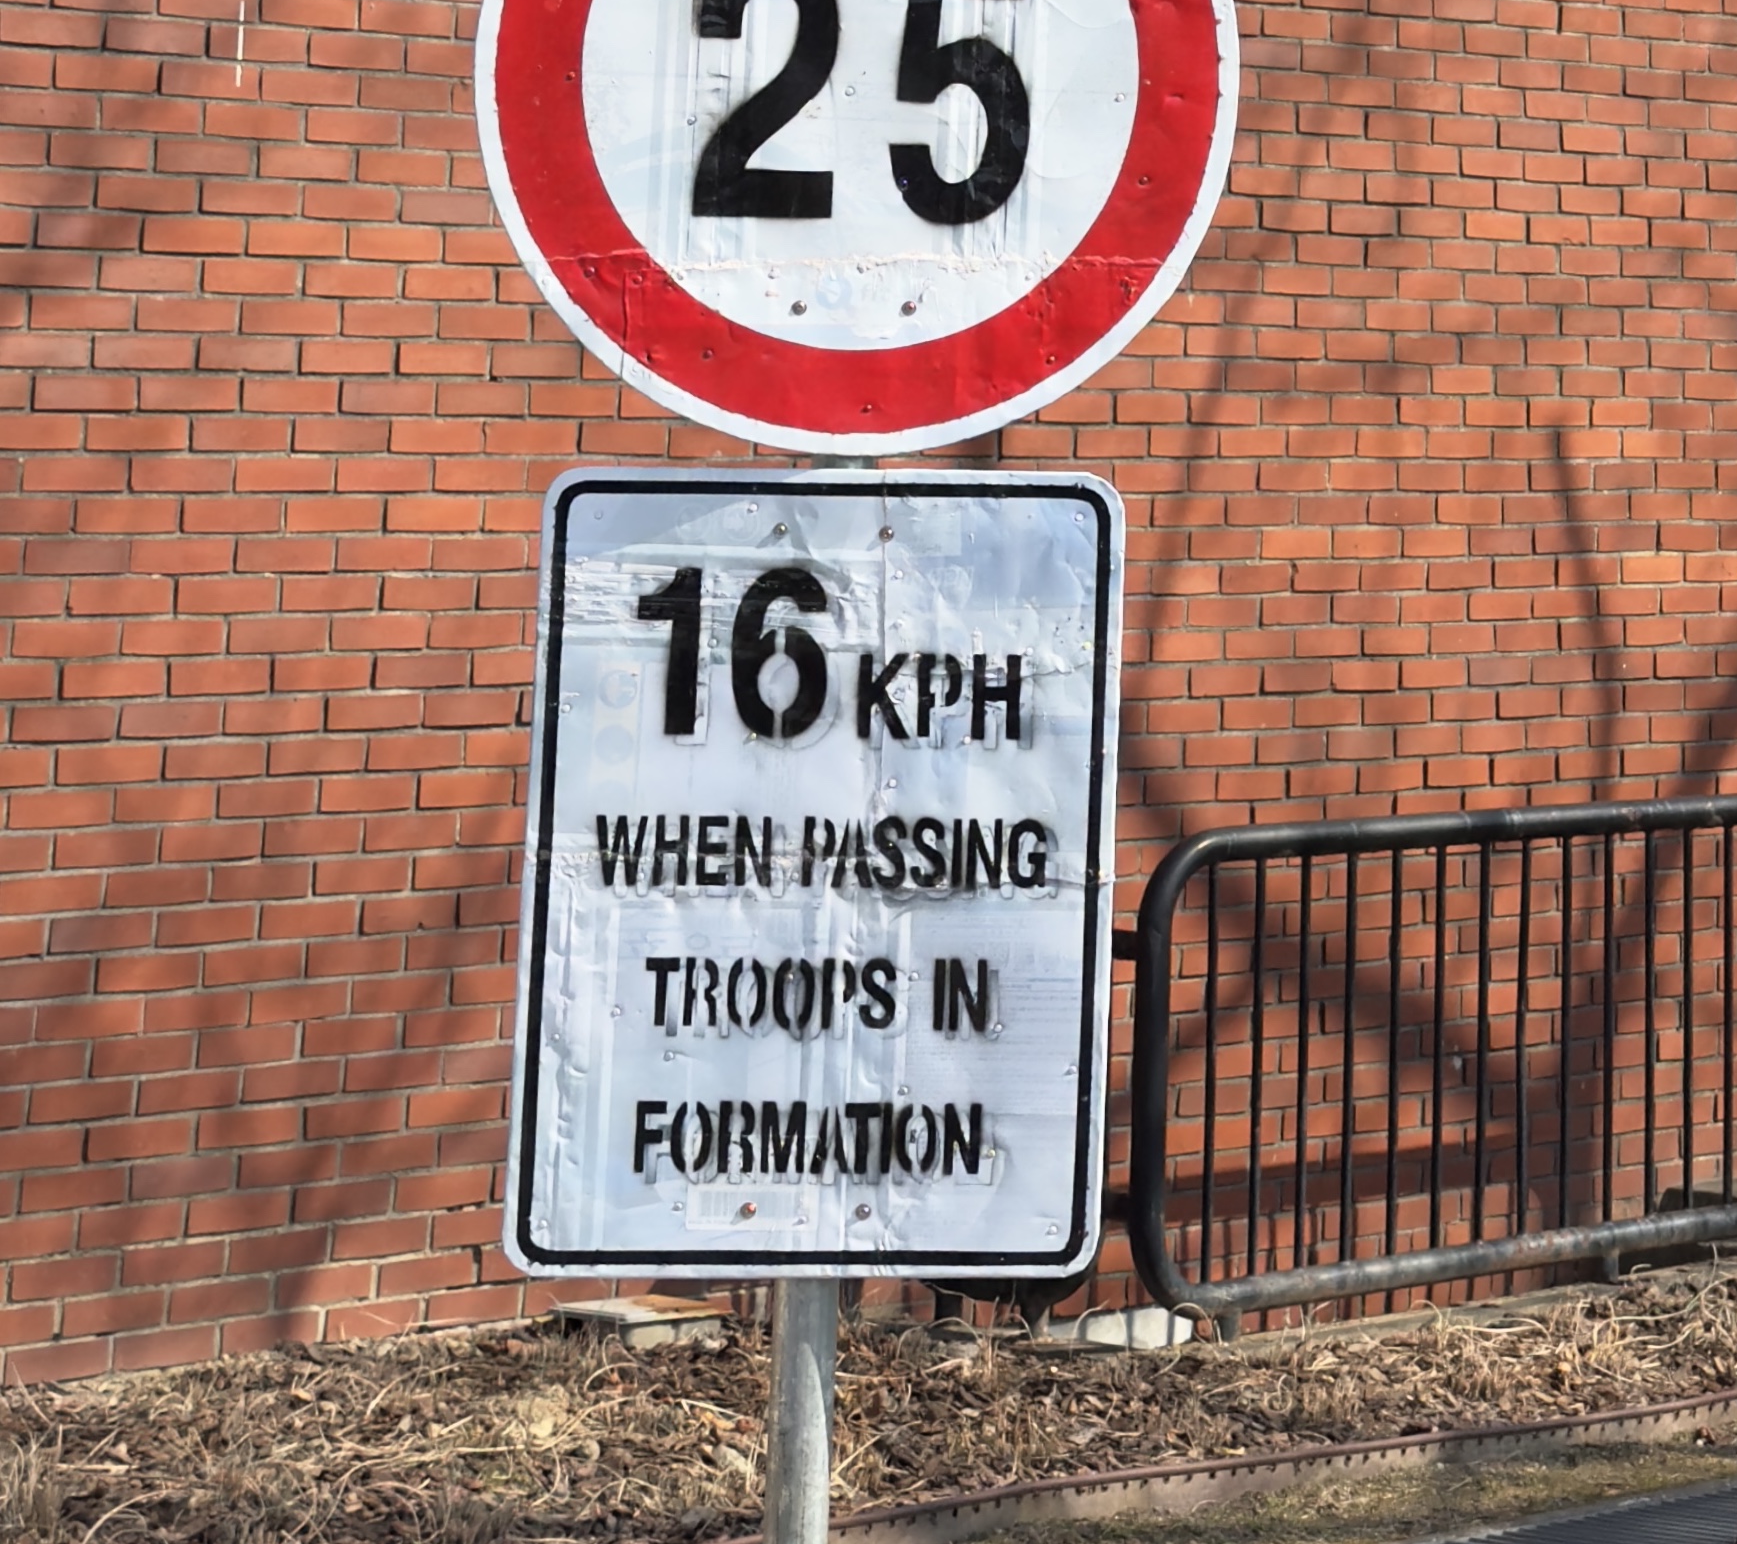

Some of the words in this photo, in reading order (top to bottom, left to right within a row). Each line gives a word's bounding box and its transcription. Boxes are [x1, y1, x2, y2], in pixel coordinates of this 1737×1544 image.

[637, 566, 828, 740] 16
[856, 652, 1024, 742] KPH
[596, 815, 772, 889] WHEN
[801, 818, 1048, 890] PASSING
[646, 957, 898, 1031] TROOPS
[932, 958, 988, 1033] IN
[633, 1100, 984, 1177] FORMATION
